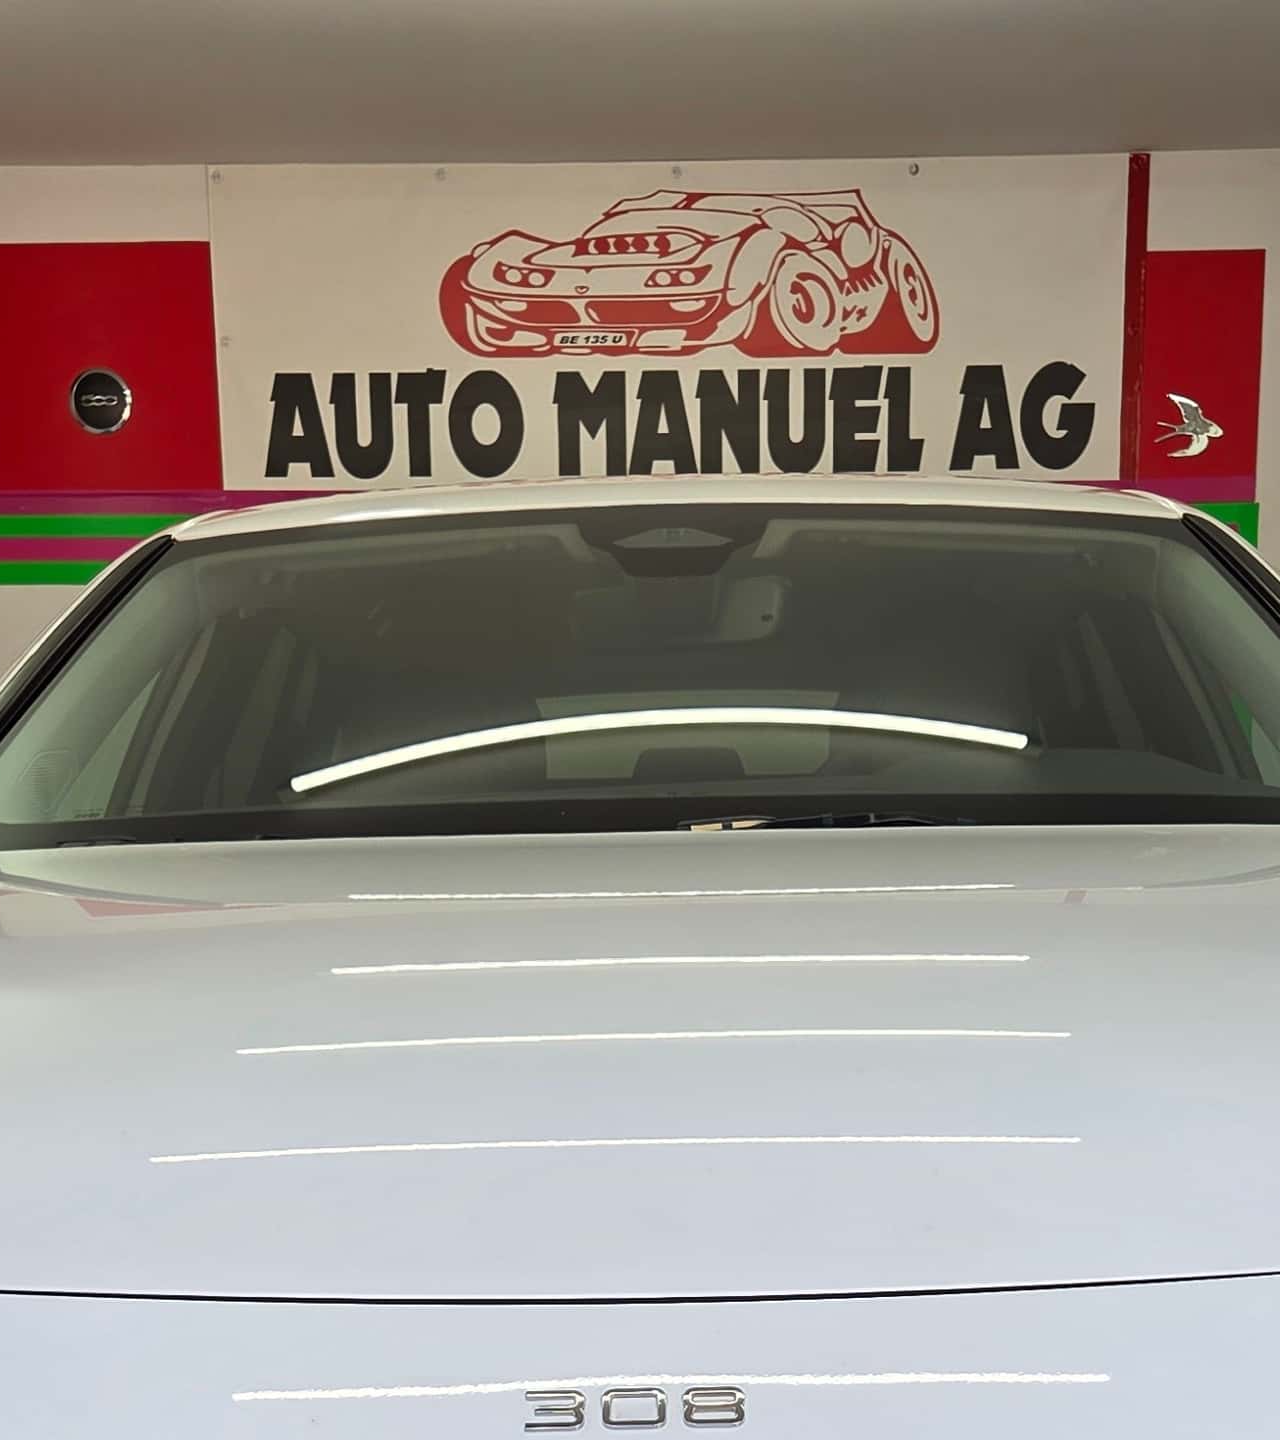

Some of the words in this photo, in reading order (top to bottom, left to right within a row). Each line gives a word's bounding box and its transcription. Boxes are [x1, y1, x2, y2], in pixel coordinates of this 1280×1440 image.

[559, 335, 580, 344] BE
[584, 335, 609, 344] 135
[612, 335, 623, 344] U
[264, 367, 524, 478] AUTO
[552, 364, 924, 476] MANUEL
[948, 359, 1096, 471] AG
[523, 1384, 748, 1433] 308
